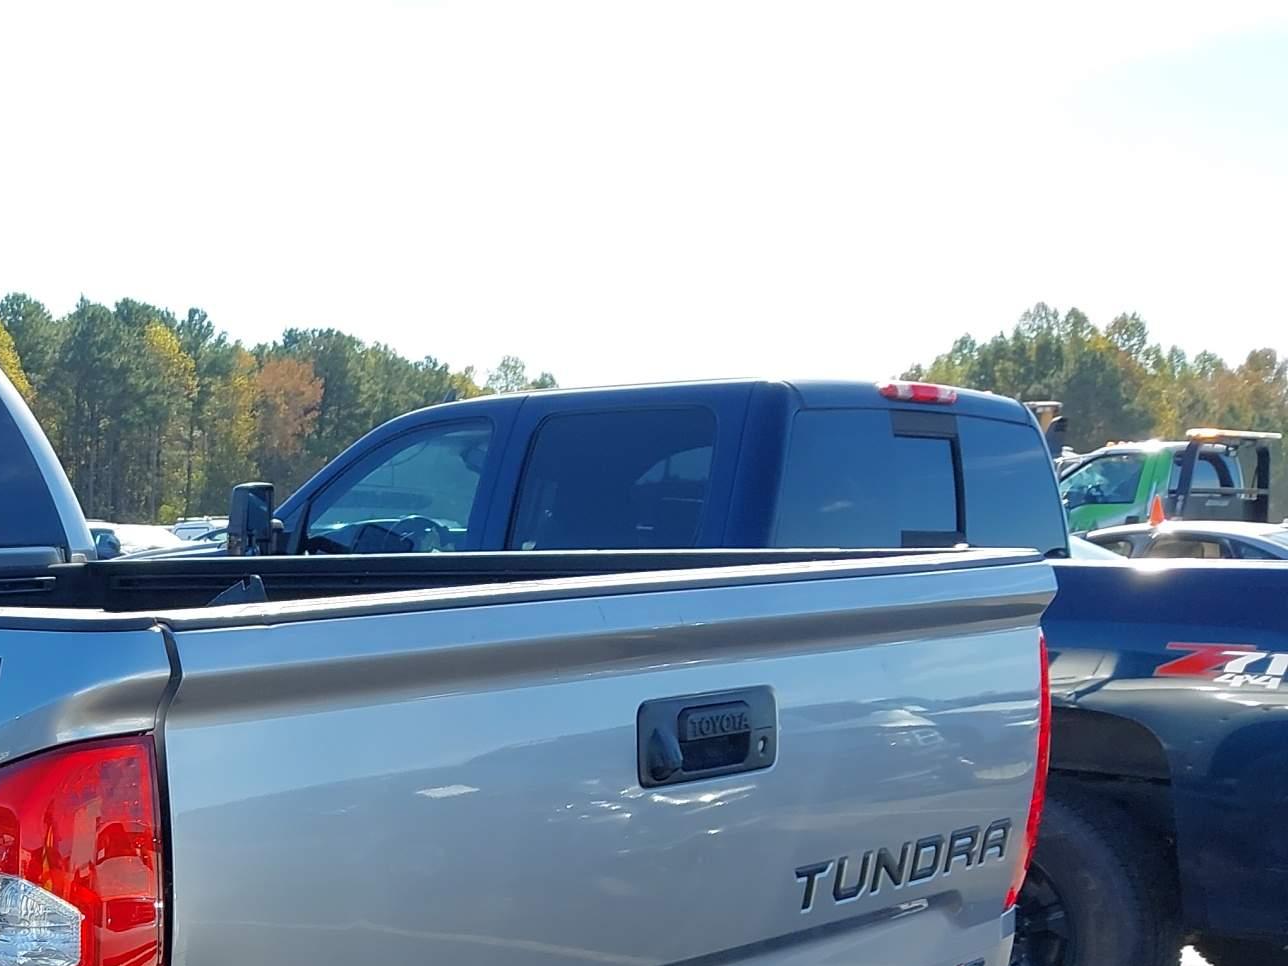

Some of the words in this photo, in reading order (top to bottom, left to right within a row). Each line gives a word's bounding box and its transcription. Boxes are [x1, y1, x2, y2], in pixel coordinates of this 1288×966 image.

[1153, 641, 1288, 678] Z71
[690, 711, 751, 737] TOYOTA
[794, 817, 1012, 913] TUNDRA
